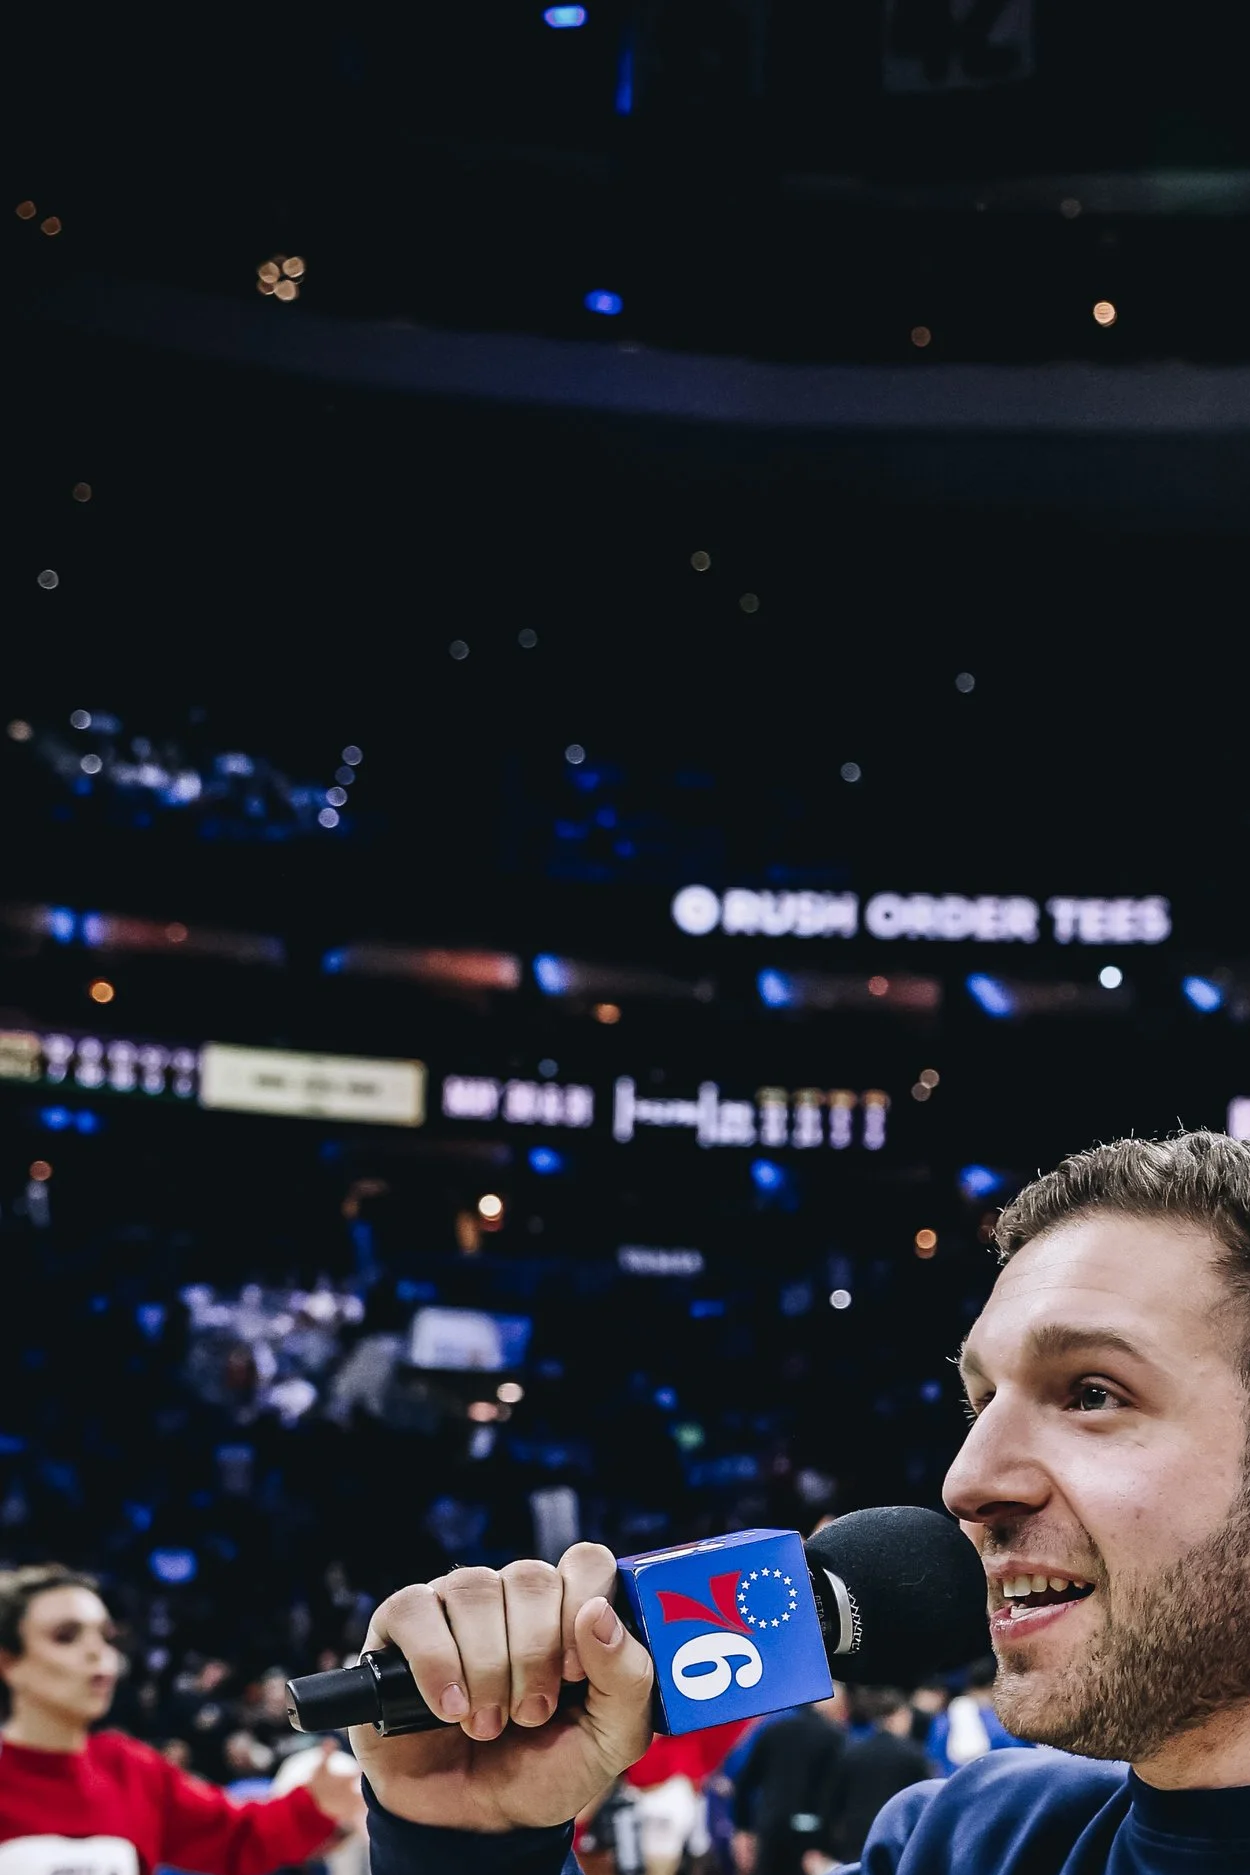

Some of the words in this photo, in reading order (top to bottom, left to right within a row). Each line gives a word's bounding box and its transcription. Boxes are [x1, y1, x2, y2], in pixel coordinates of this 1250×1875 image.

[722, 888, 858, 937] RUSH
[865, 892, 1040, 942] ORDER
[1046, 895, 1171, 944] TEES
[656, 1571, 763, 1701] 76
